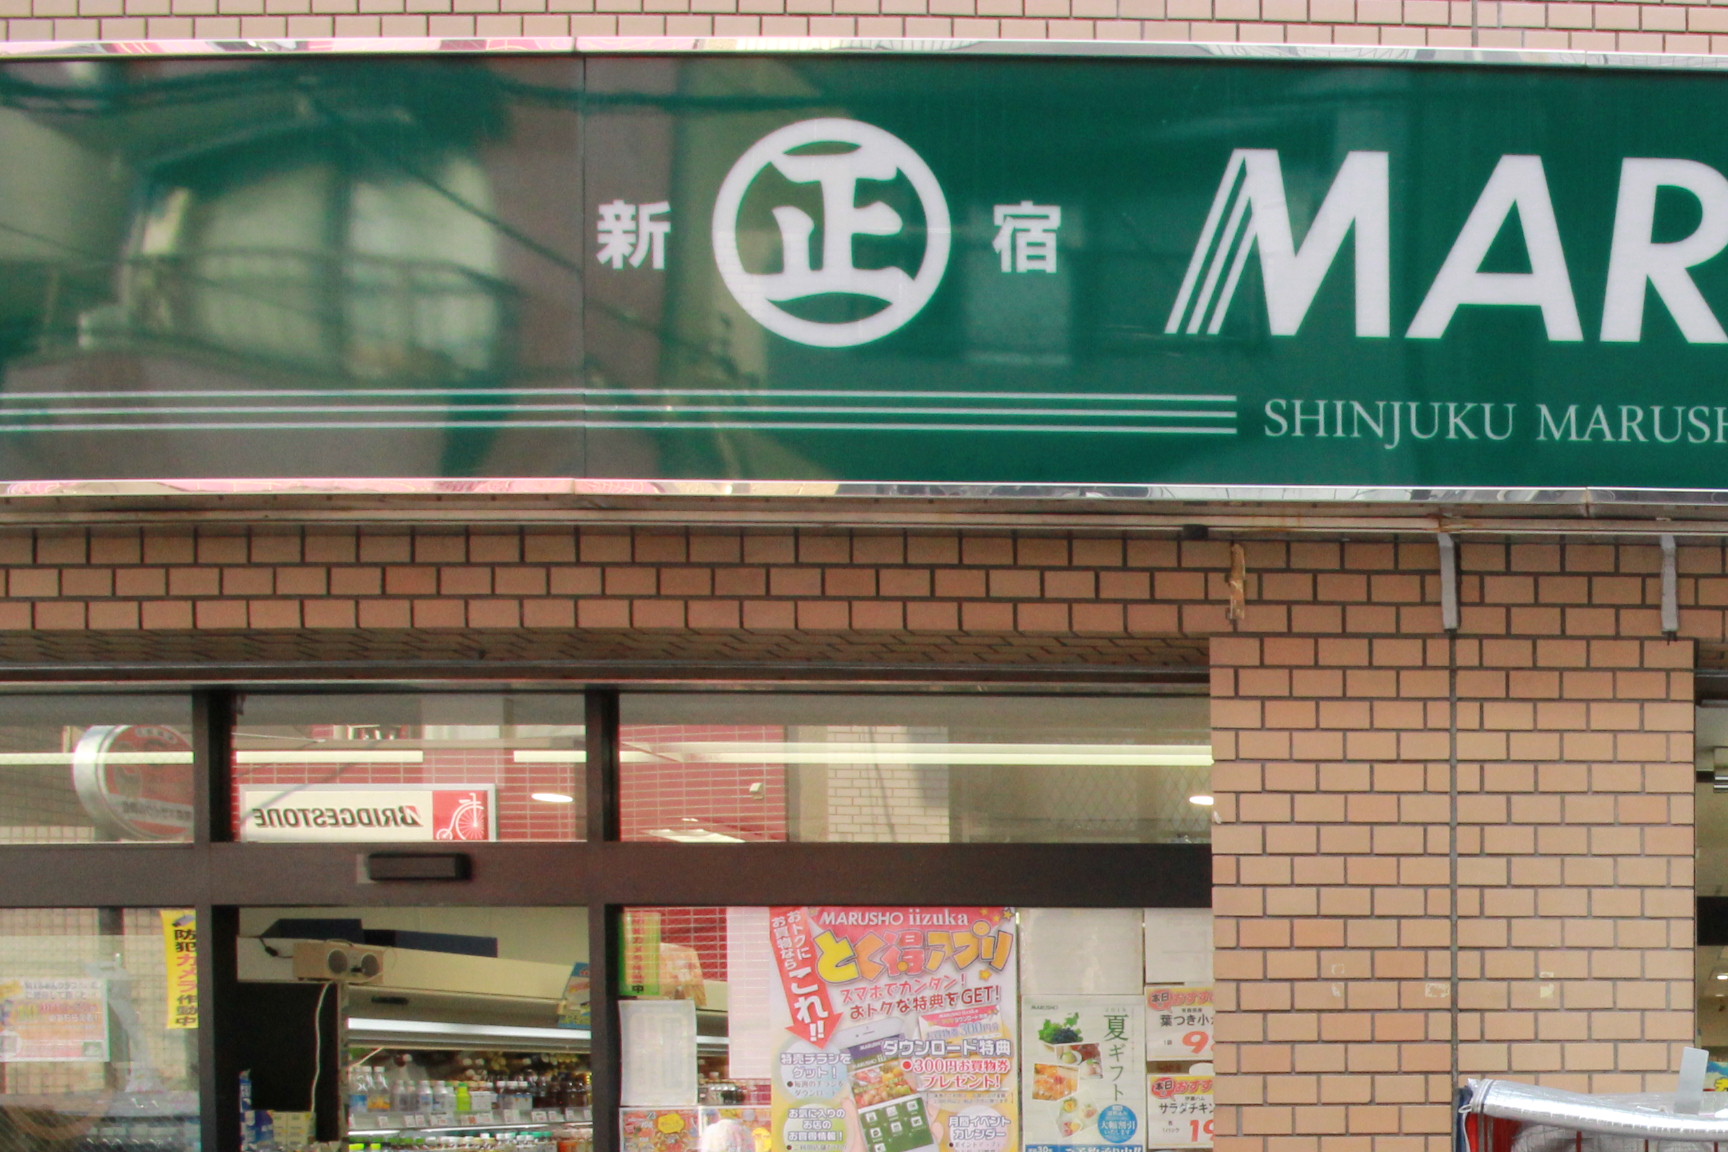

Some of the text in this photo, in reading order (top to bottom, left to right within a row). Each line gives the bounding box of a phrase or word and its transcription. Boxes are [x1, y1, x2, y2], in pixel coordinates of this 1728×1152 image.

[597, 200, 671, 270] 新
[993, 203, 1060, 274] 宿
[1262, 398, 1516, 447] SHINJUKU
[819, 908, 968, 926] MARUSHO iizuka
[883, 1040, 1011, 1057] ダウンロード特典
[1103, 1013, 1129, 1101] 夏ギフト
[923, 1074, 1001, 1088] プレゼント!
